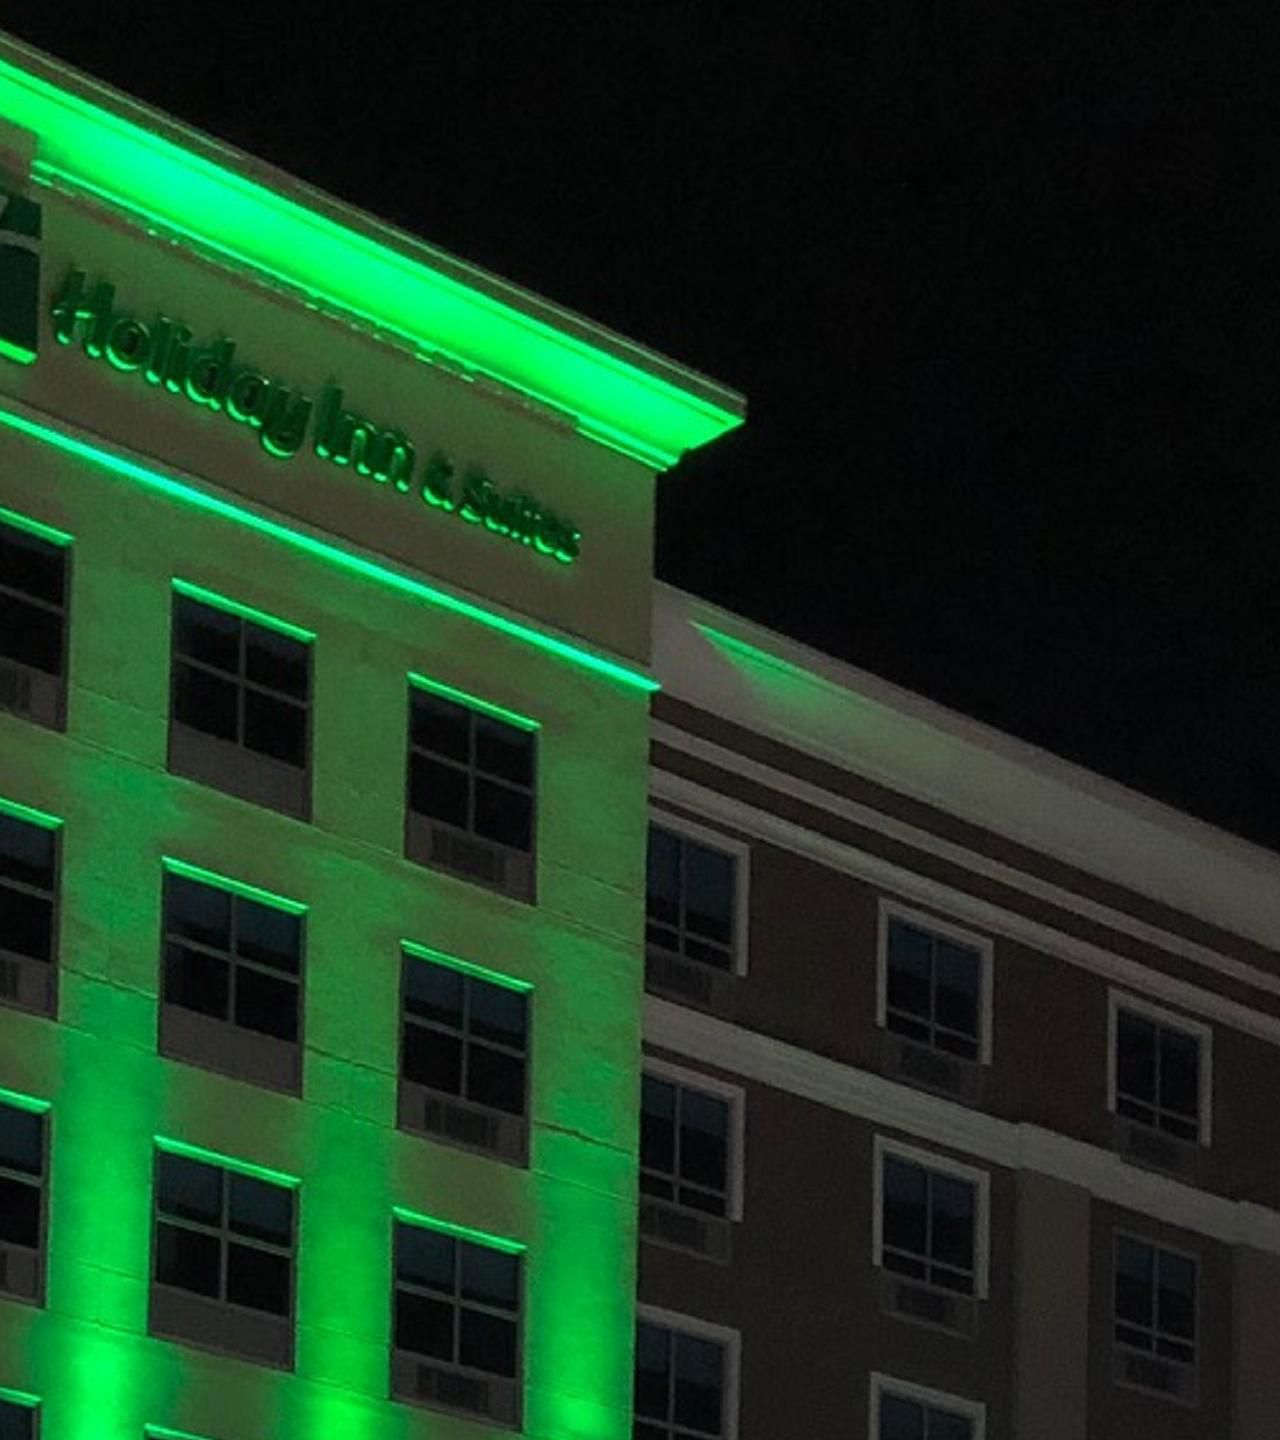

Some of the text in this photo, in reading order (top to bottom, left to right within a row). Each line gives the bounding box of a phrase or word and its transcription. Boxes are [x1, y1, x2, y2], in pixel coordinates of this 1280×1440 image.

[51, 266, 313, 459] Holiday
[314, 385, 414, 492] Inn
[458, 472, 581, 565] Suites
